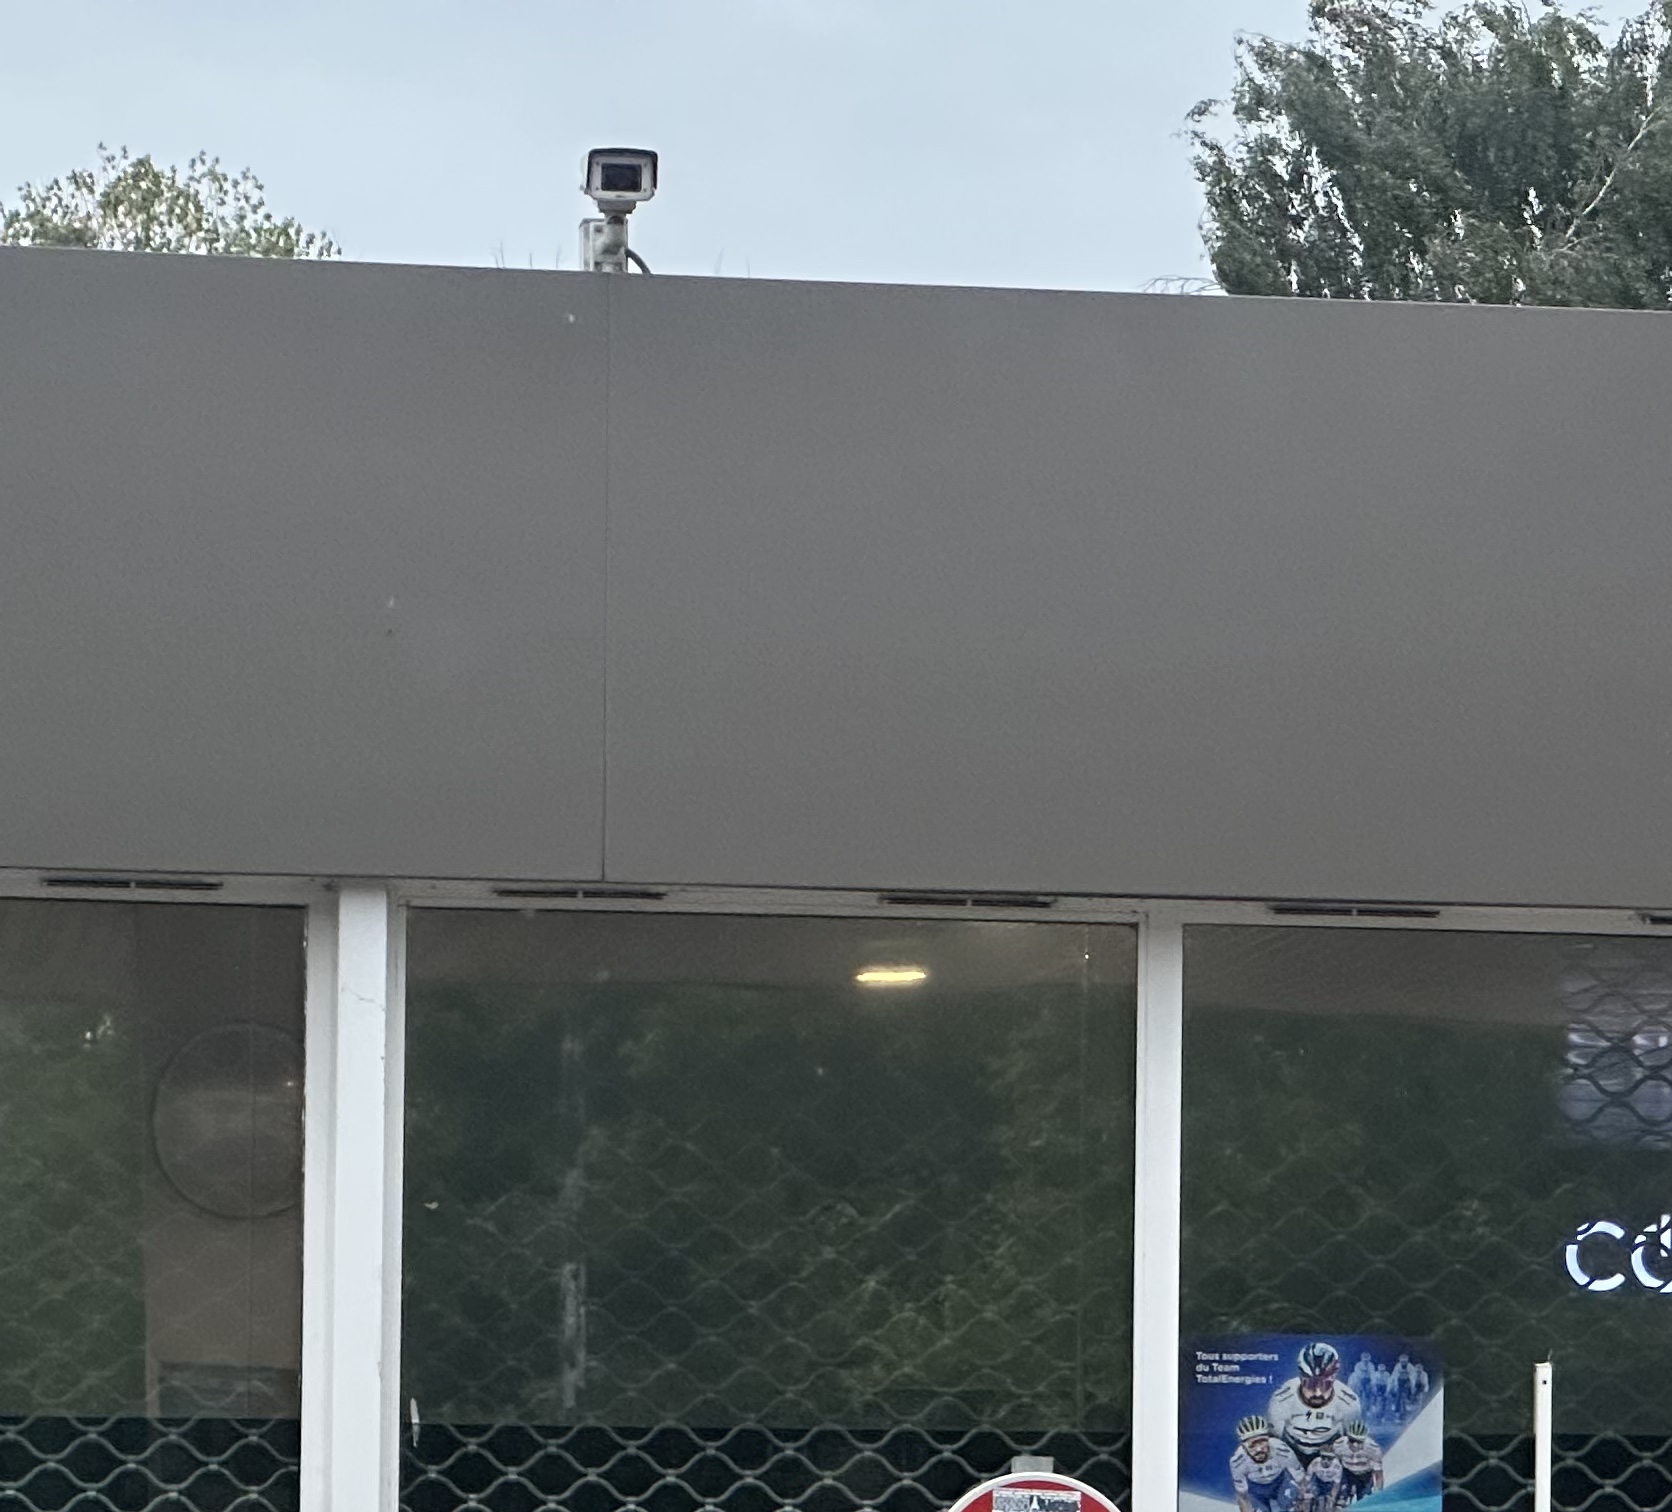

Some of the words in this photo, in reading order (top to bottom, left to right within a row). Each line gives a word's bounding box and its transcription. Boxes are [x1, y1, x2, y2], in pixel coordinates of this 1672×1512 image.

[1195, 1351, 1220, 1361] Tous
[1222, 1352, 1279, 1362] supporters
[1195, 1362, 1210, 1373] du
[1212, 1362, 1241, 1373] Team
[1195, 1374, 1267, 1386] TotalEnergies
